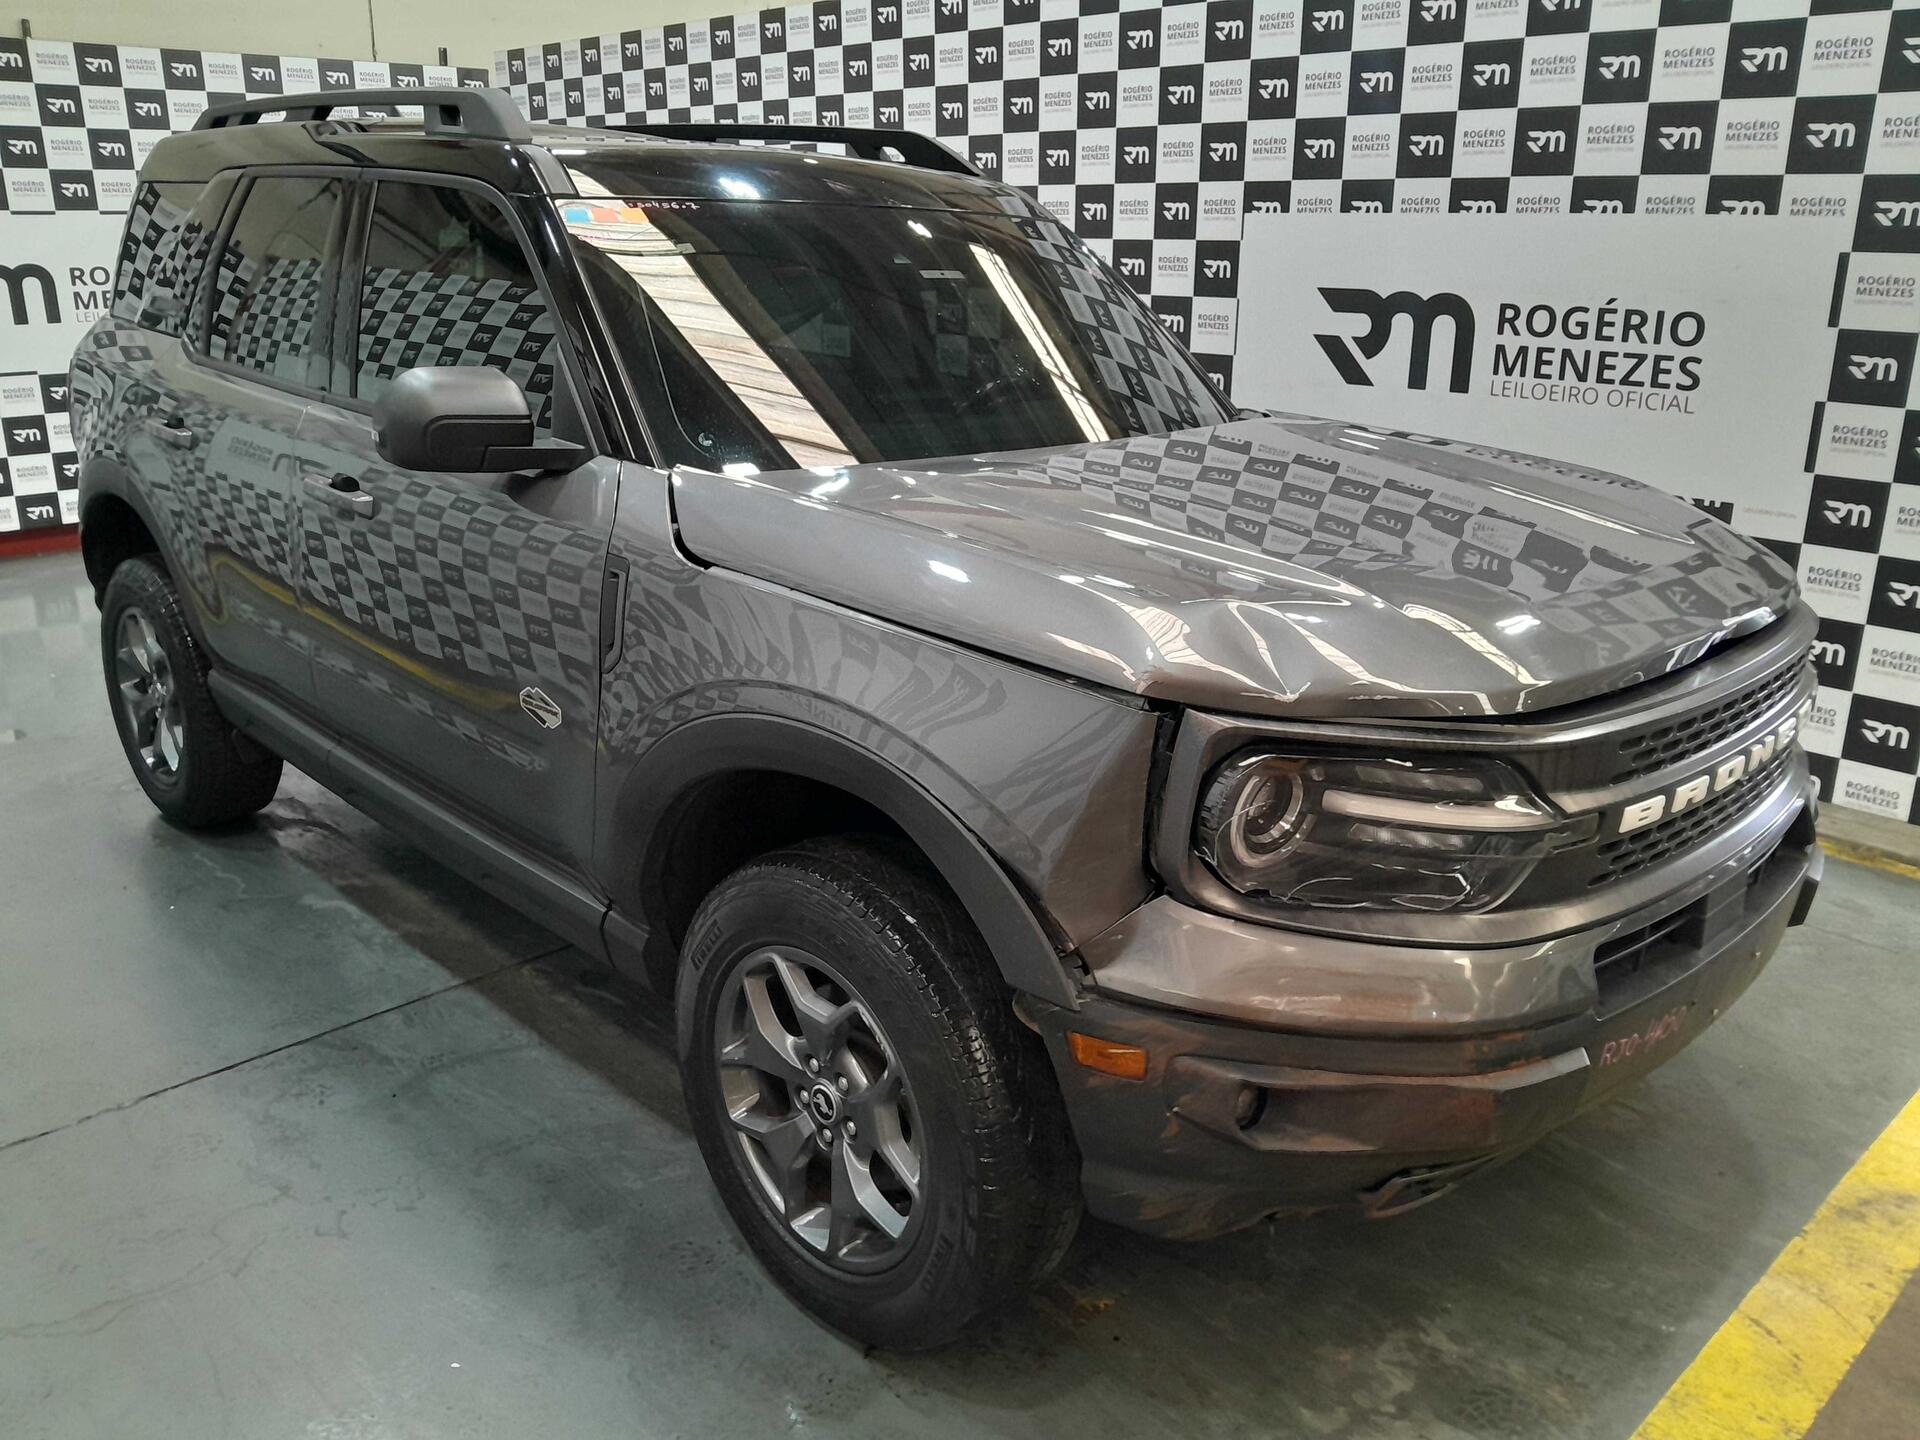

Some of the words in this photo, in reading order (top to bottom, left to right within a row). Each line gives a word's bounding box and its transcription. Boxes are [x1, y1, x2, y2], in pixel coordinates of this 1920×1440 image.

[1361, 9, 1401, 21] MENEZES
[1259, 20, 1294, 31] MENEZES
[1815, 36, 1873, 49] ROGÉRIO
[1664, 46, 1715, 59] ROGÉRIO
[1813, 48, 1872, 61] MENEZES
[1663, 57, 1714, 69] MENEZES
[1530, 65, 1576, 76] MENEZES
[1411, 73, 1452, 83] MENEZES
[1305, 80, 1341, 90] MENEZES
[1588, 124, 1635, 135] ROGÉRIO
[1727, 120, 1780, 131] ROGÉRIO
[1587, 135, 1634, 144] MENEZES
[1725, 131, 1778, 142] MENEZES
[1352, 143, 1390, 151] MENEZES
[1463, 139, 1505, 148] MENEZES
[1252, 146, 1287, 154] MENEZES
[1646, 195, 1695, 206] ROGÉRIO
[1791, 196, 1846, 207] ROGÉRIO
[1857, 275, 1916, 287] ROGÉRIO
[1856, 287, 1914, 298] MENEZES
[1496, 298, 1706, 347] ROGÉRIO
[1491, 343, 1703, 392] MENEZES
[1490, 379, 1599, 406] LEILOEIRO
[1606, 388, 1695, 415] OFICIAL
[1833, 425, 1888, 439] ROGÉRIO
[1831, 435, 1887, 449] MENEZES
[1808, 566, 1862, 582] ROGÉRIO
[1807, 576, 1860, 592] MENEZES
[1846, 781, 1900, 800] ROGÉRIO
[1845, 789, 1898, 810] MENEZES
